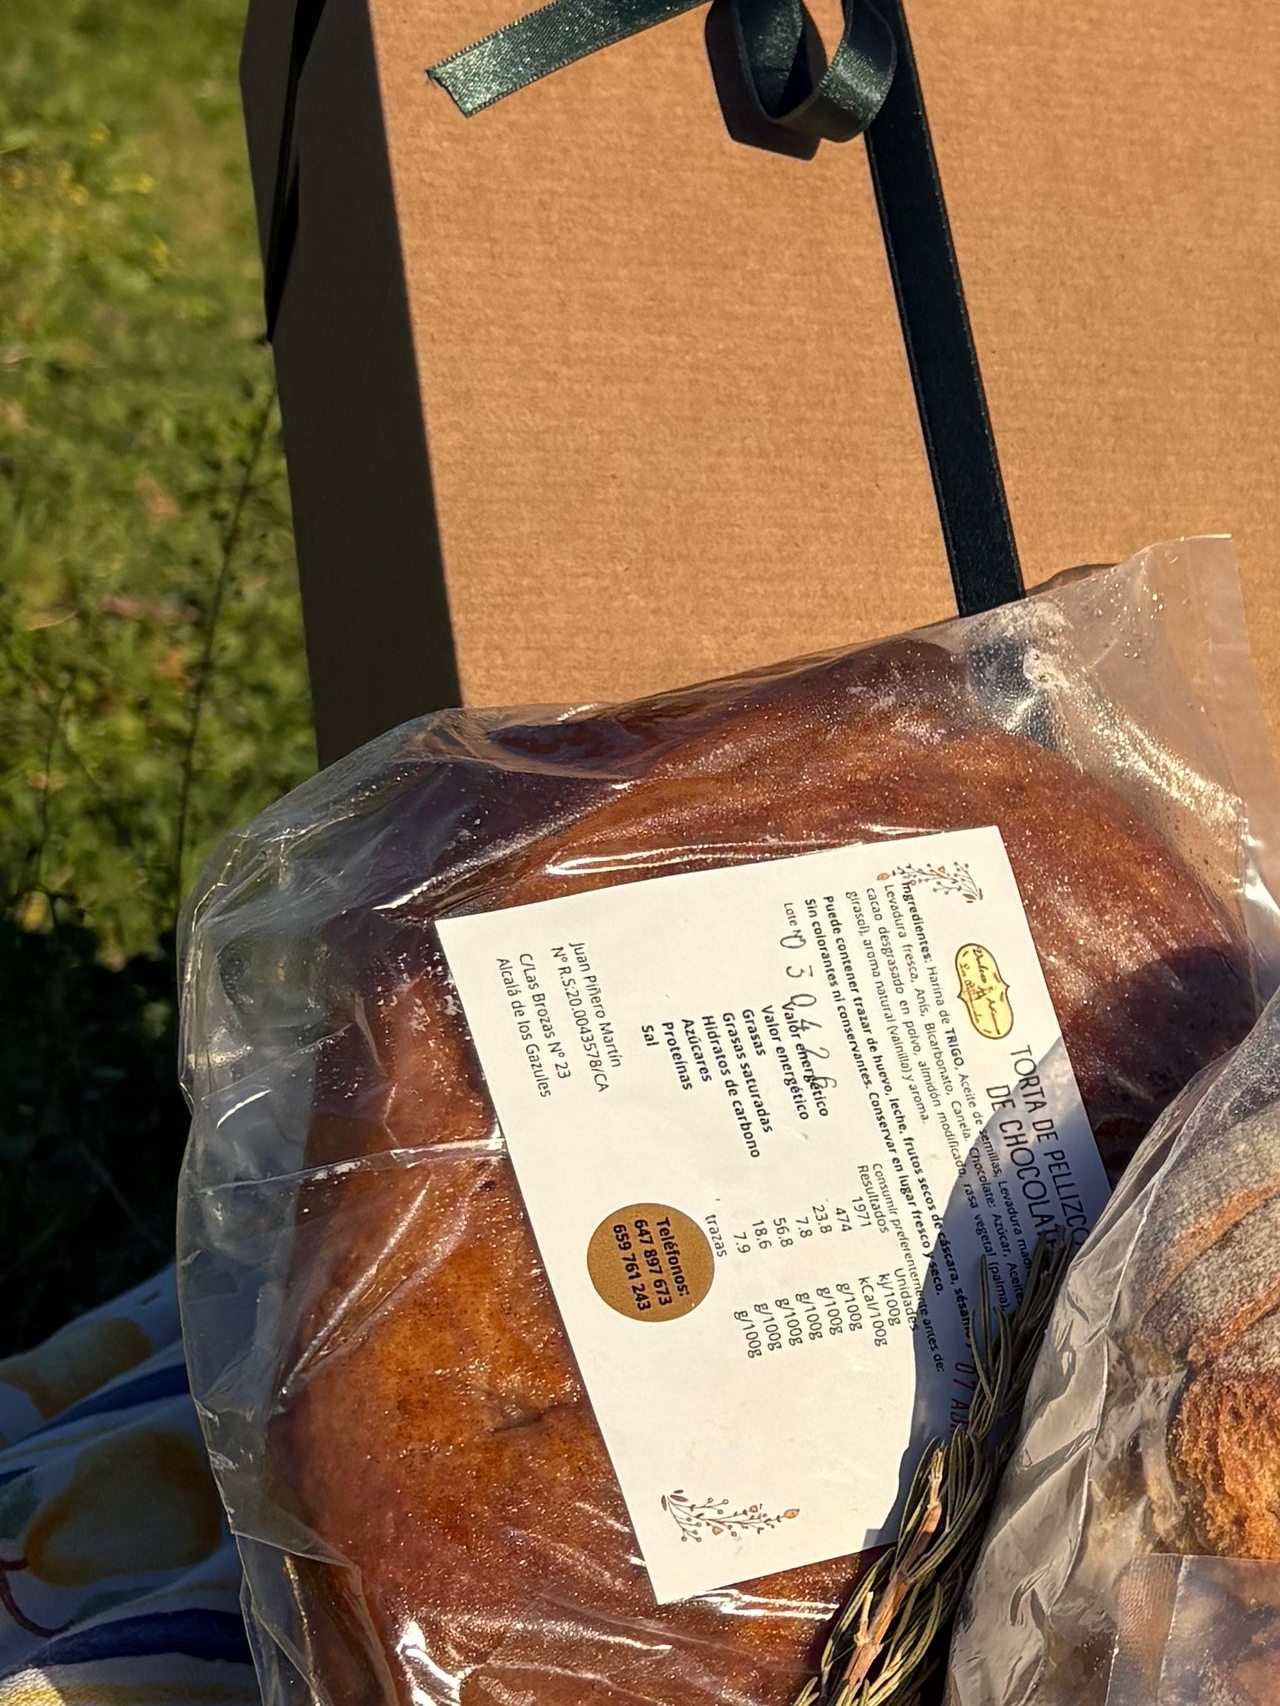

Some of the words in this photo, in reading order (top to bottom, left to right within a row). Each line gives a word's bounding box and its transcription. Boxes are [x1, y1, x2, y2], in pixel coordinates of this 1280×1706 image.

[900, 878, 933, 965] Ingredientes:
[494, 957, 523, 998] Alcalá
[925, 965, 946, 1008] Harina
[509, 999, 528, 1019] de
[518, 952, 541, 991] C/Las
[530, 991, 557, 1040] Brozas
[553, 1060, 573, 1080] 23
[567, 941, 592, 974] Juan
[582, 973, 607, 1020] Piñero
[597, 1020, 624, 1069] Martín
[937, 1008, 952, 1026] de
[515, 1019, 534, 1042] los
[640, 1023, 661, 1048] Sal
[680, 1017, 714, 1084] Azúcares
[700, 1014, 733, 1077] Hidratos
[740, 1007, 768, 1058] Grasas
[943, 1025, 966, 1071] TRIGO,
[524, 1042, 553, 1099] Gazules
[660, 1020, 694, 1092] Proteínas
[721, 1011, 748, 1061] Grasas
[738, 1061, 774, 1134] saturadas
[760, 1003, 783, 1043] Valor
[774, 1045, 811, 1122] energético
[780, 998, 805, 1041] Valor
[794, 1041, 830, 1118] energético
[723, 1078, 741, 1098] de
[957, 1072, 978, 1110] Aceite
[984, 1083, 1018, 1113] DE
[1008, 1043, 1049, 1115] TORTA
[1030, 1117, 1060, 1144] DE
[731, 1098, 762, 1159] carbono
[971, 1110, 985, 1127] de
[977, 1126, 1004, 1179] semillas,
[810, 1203, 834, 1235] 23.8
[834, 1206, 854, 1234] 474
[850, 1195, 874, 1228] 1971
[856, 1163, 891, 1235] Resultados
[996, 1179, 1024, 1237] Levadura
[611, 1223, 634, 1252] 659
[632, 1217, 656, 1246] 647
[703, 1212, 729, 1259] trazas
[731, 1230, 752, 1255] 7.9
[750, 1218, 774, 1251] 18.6
[771, 1216, 795, 1249] 56.8
[794, 1215, 815, 1240] 7.8
[620, 1252, 643, 1281] 761
[642, 1247, 665, 1276] 897
[654, 1215, 691, 1298] Teléfonos:
[630, 1281, 653, 1312] 243
[652, 1277, 674, 1307] 673
[834, 1281, 864, 1333] g/100g
[856, 1275, 889, 1349] kCal/100g
[875, 1271, 903, 1328] kj/100g
[892, 1266, 920, 1333] Unidades
